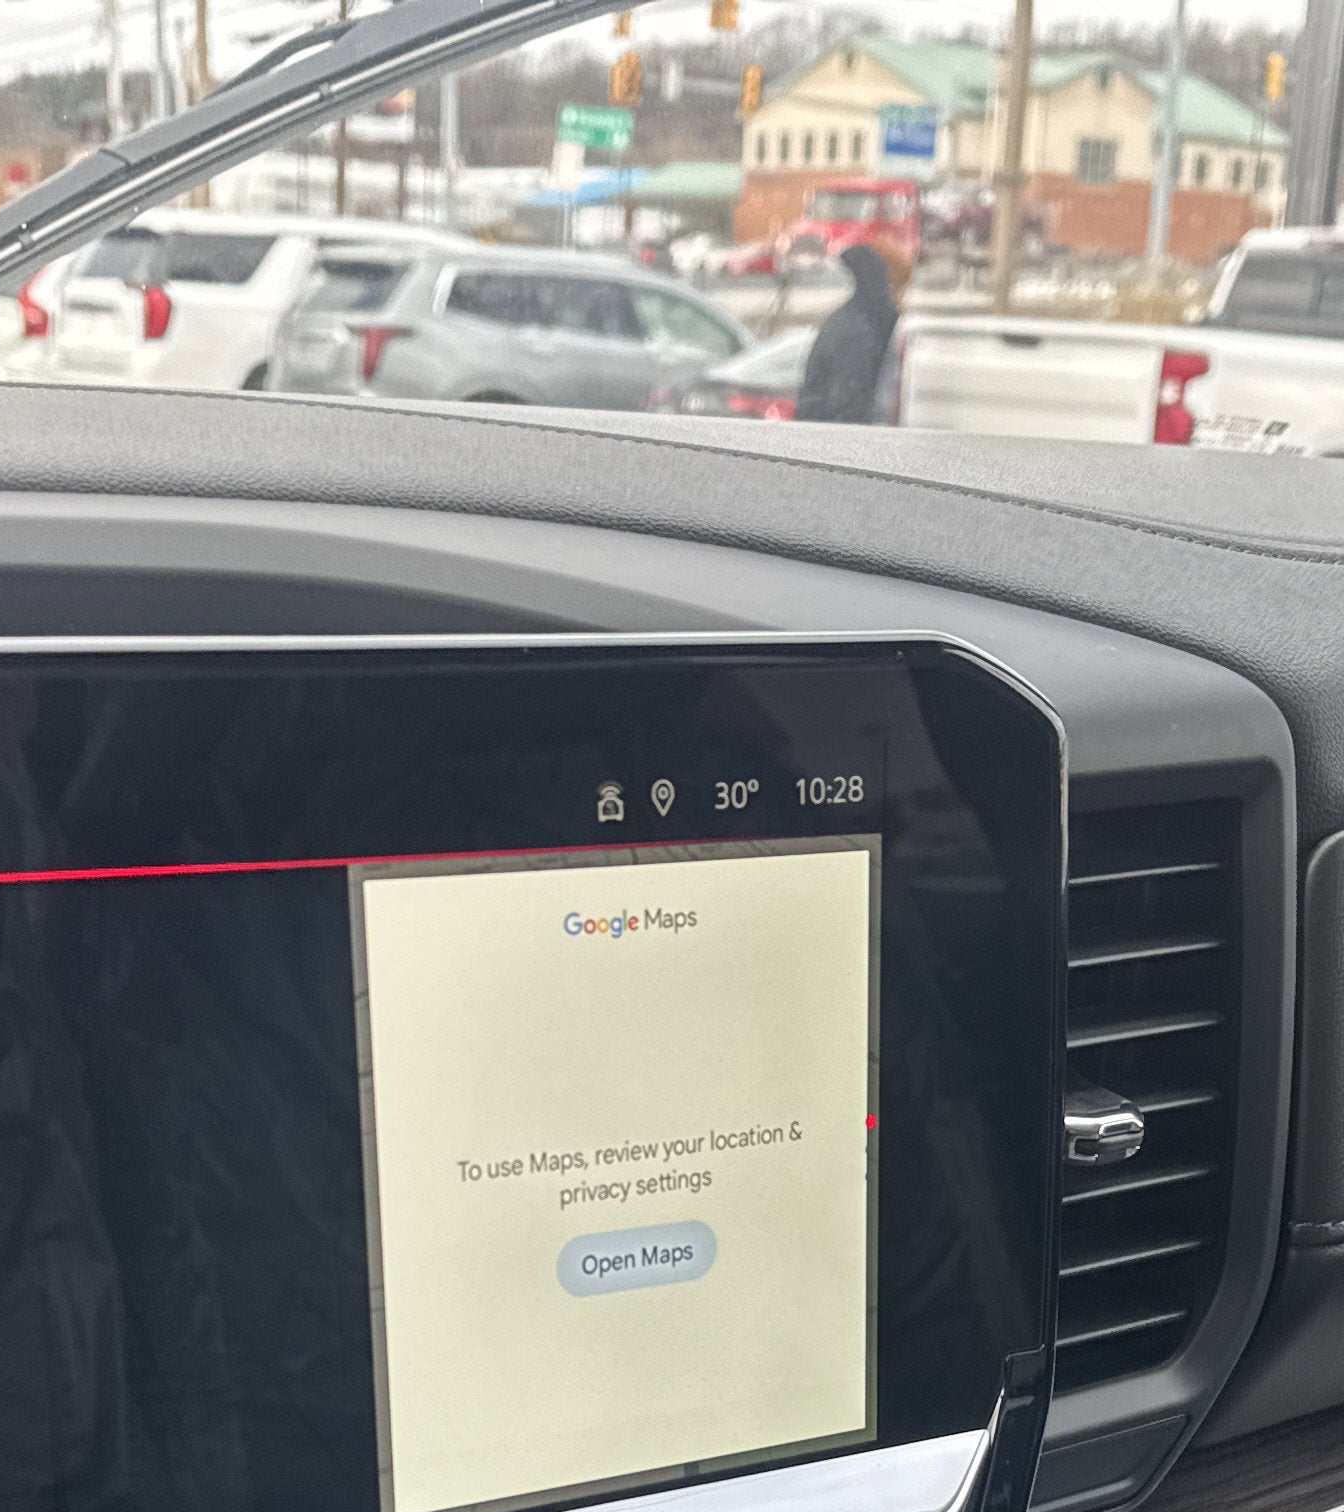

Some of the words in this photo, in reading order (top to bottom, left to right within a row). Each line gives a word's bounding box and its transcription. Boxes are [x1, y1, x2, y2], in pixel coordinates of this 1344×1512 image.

[795, 775, 864, 805] 10:28
[563, 909, 639, 939] Google
[643, 908, 698, 933] Maps
[457, 1160, 482, 1182] To
[487, 1157, 524, 1179] use
[529, 1151, 589, 1175] Maps,
[594, 1140, 657, 1166] review
[662, 1136, 705, 1162] your
[710, 1124, 784, 1151] location
[788, 1121, 803, 1141] &
[559, 1179, 631, 1210] privacy
[636, 1167, 713, 1196] settings
[581, 1250, 636, 1278] Open
[641, 1244, 694, 1268] Maps
